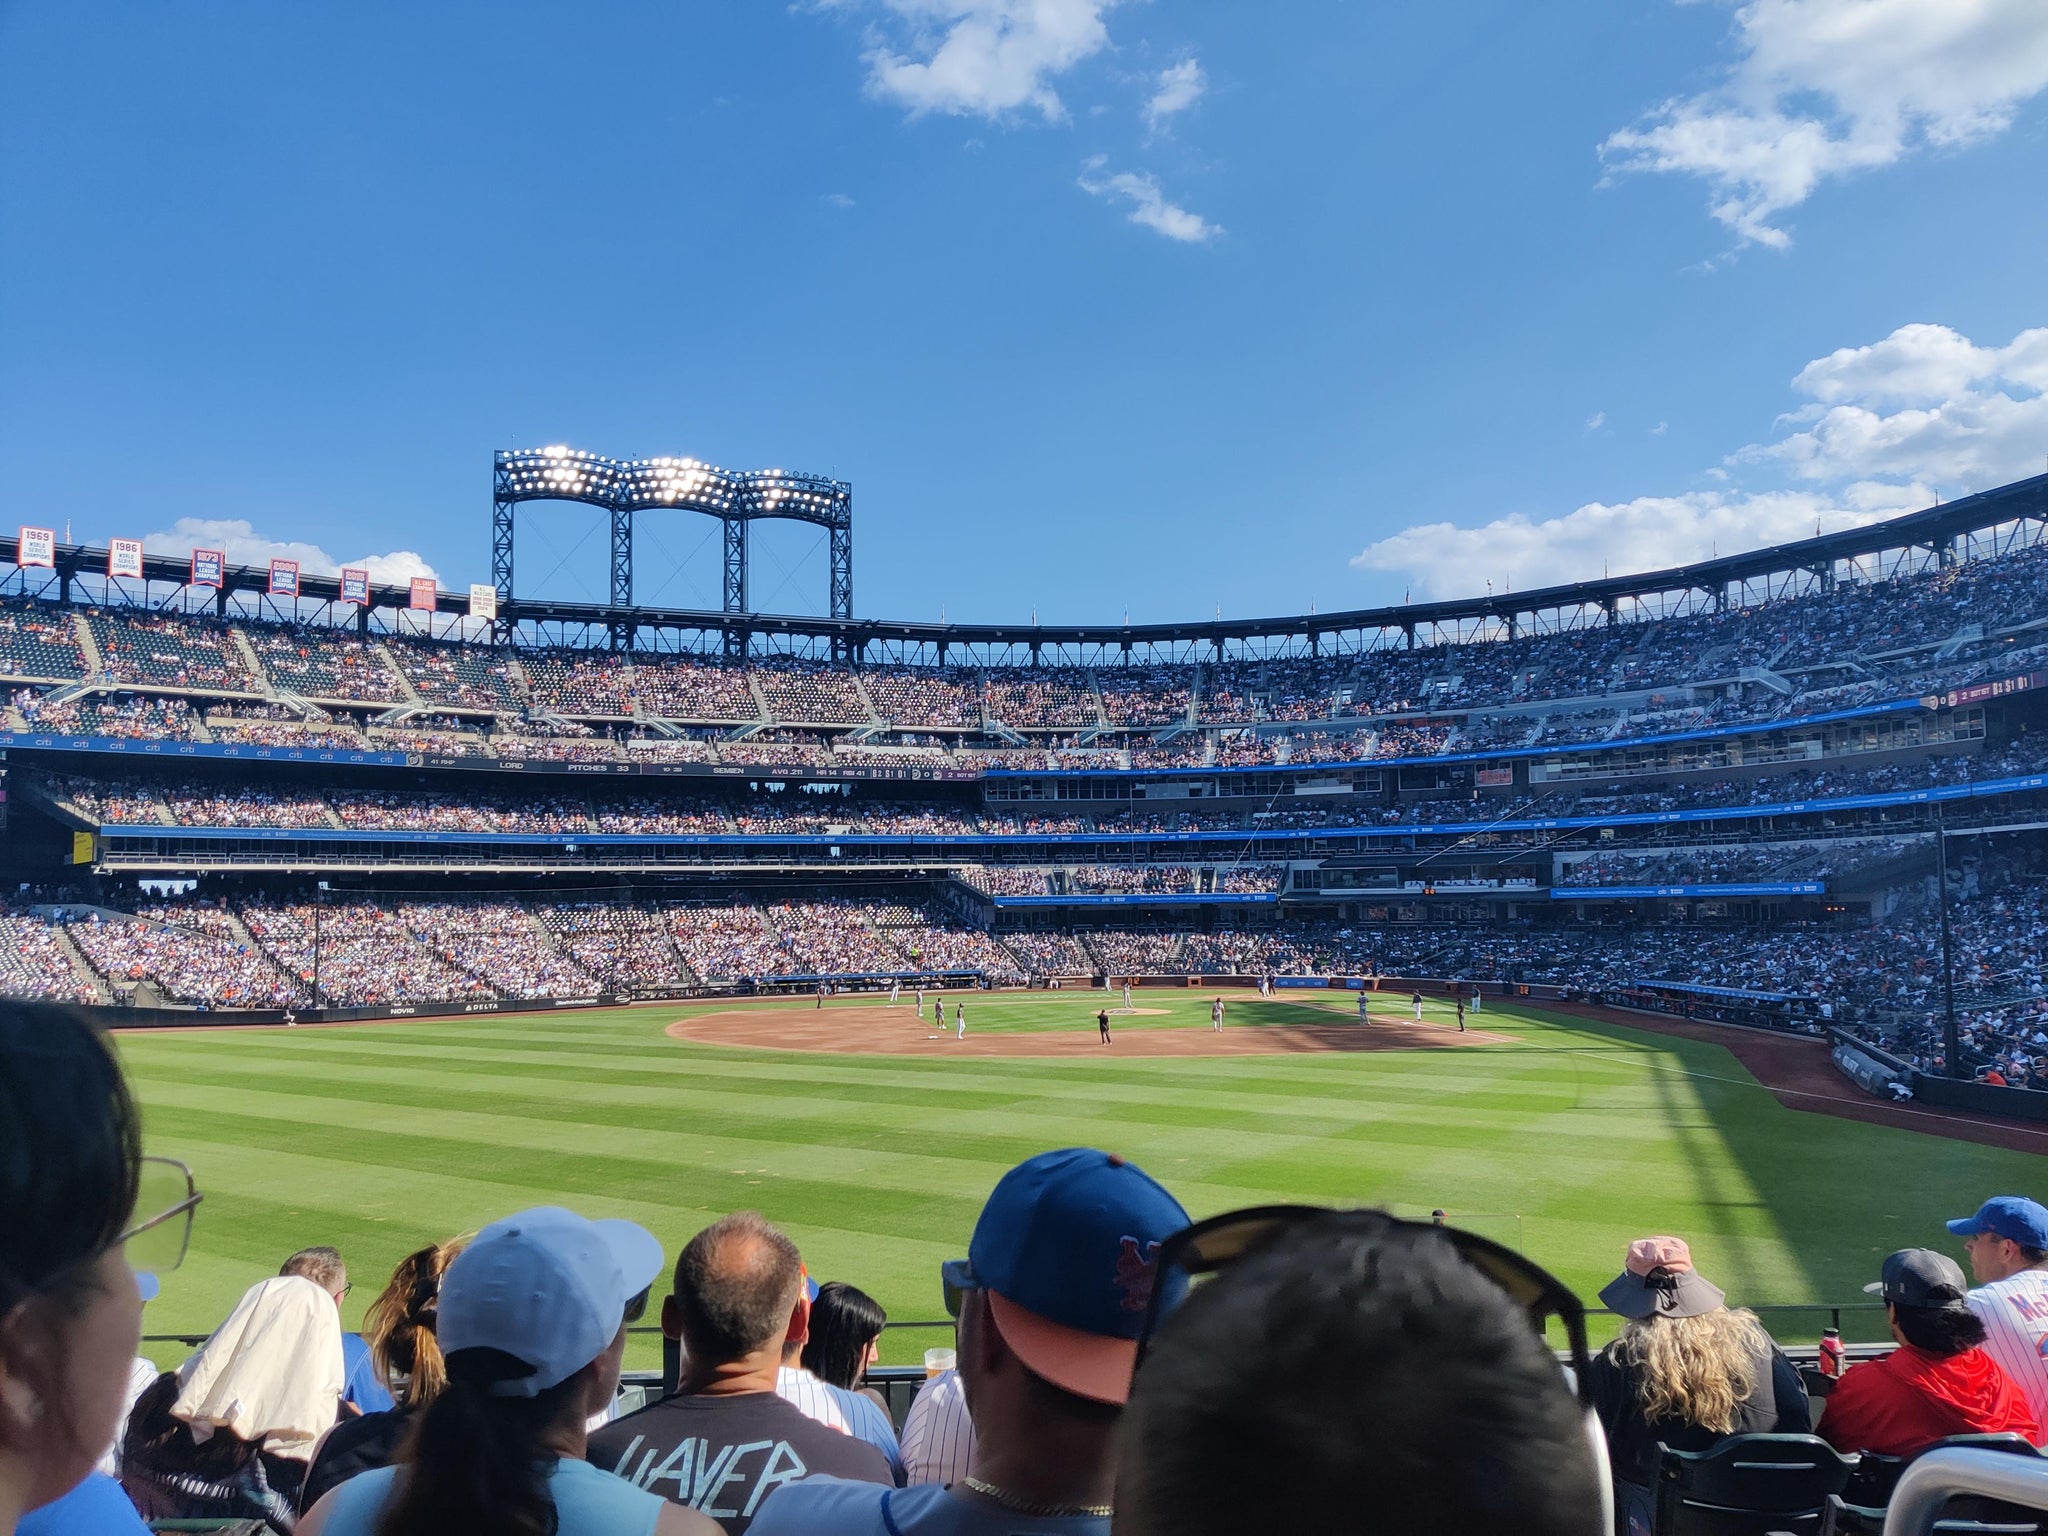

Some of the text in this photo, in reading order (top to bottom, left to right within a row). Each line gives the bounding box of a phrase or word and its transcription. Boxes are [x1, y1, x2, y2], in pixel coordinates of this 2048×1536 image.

[26, 531, 50, 542] 1969
[116, 542, 138, 553] 1986
[24, 551, 51, 561] CHAMPIONS
[113, 563, 139, 571] CHAMPIONS
[1961, 691, 1968, 700] 2
[36, 738, 52, 747] citi
[73, 739, 89, 748] citi
[110, 741, 126, 750] citi
[145, 743, 161, 752] citi
[180, 744, 195, 753] citi
[224, 748, 239, 756] citi
[257, 749, 271, 758] citi
[289, 751, 303, 759] citi
[320, 752, 334, 760] citi
[350, 754, 364, 762] citi
[380, 755, 393, 763] citi
[500, 762, 524, 770] LORD
[568, 764, 607, 772] PITCHES
[390, 1007, 415, 1015] NOVIG
